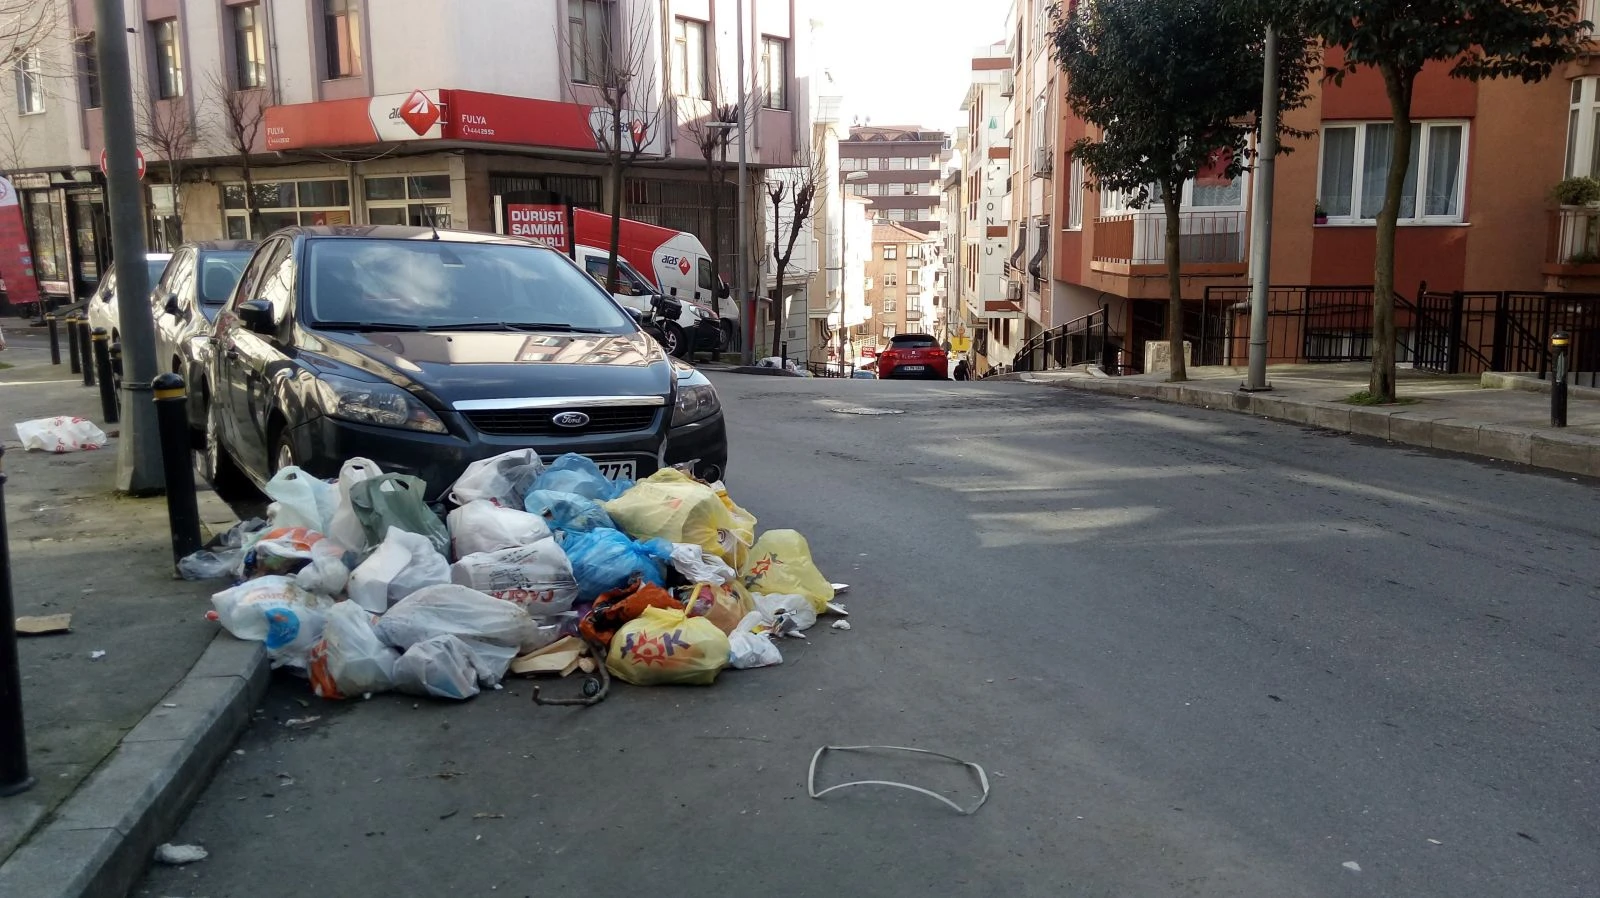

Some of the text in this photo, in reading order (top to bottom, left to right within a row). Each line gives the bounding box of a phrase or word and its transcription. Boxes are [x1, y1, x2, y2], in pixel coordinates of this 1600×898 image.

[461, 113, 487, 125] FULYA
[511, 208, 563, 222] DÜRÜST
[512, 221, 565, 235] SAMİMİ
[561, 414, 582, 424] Ford
